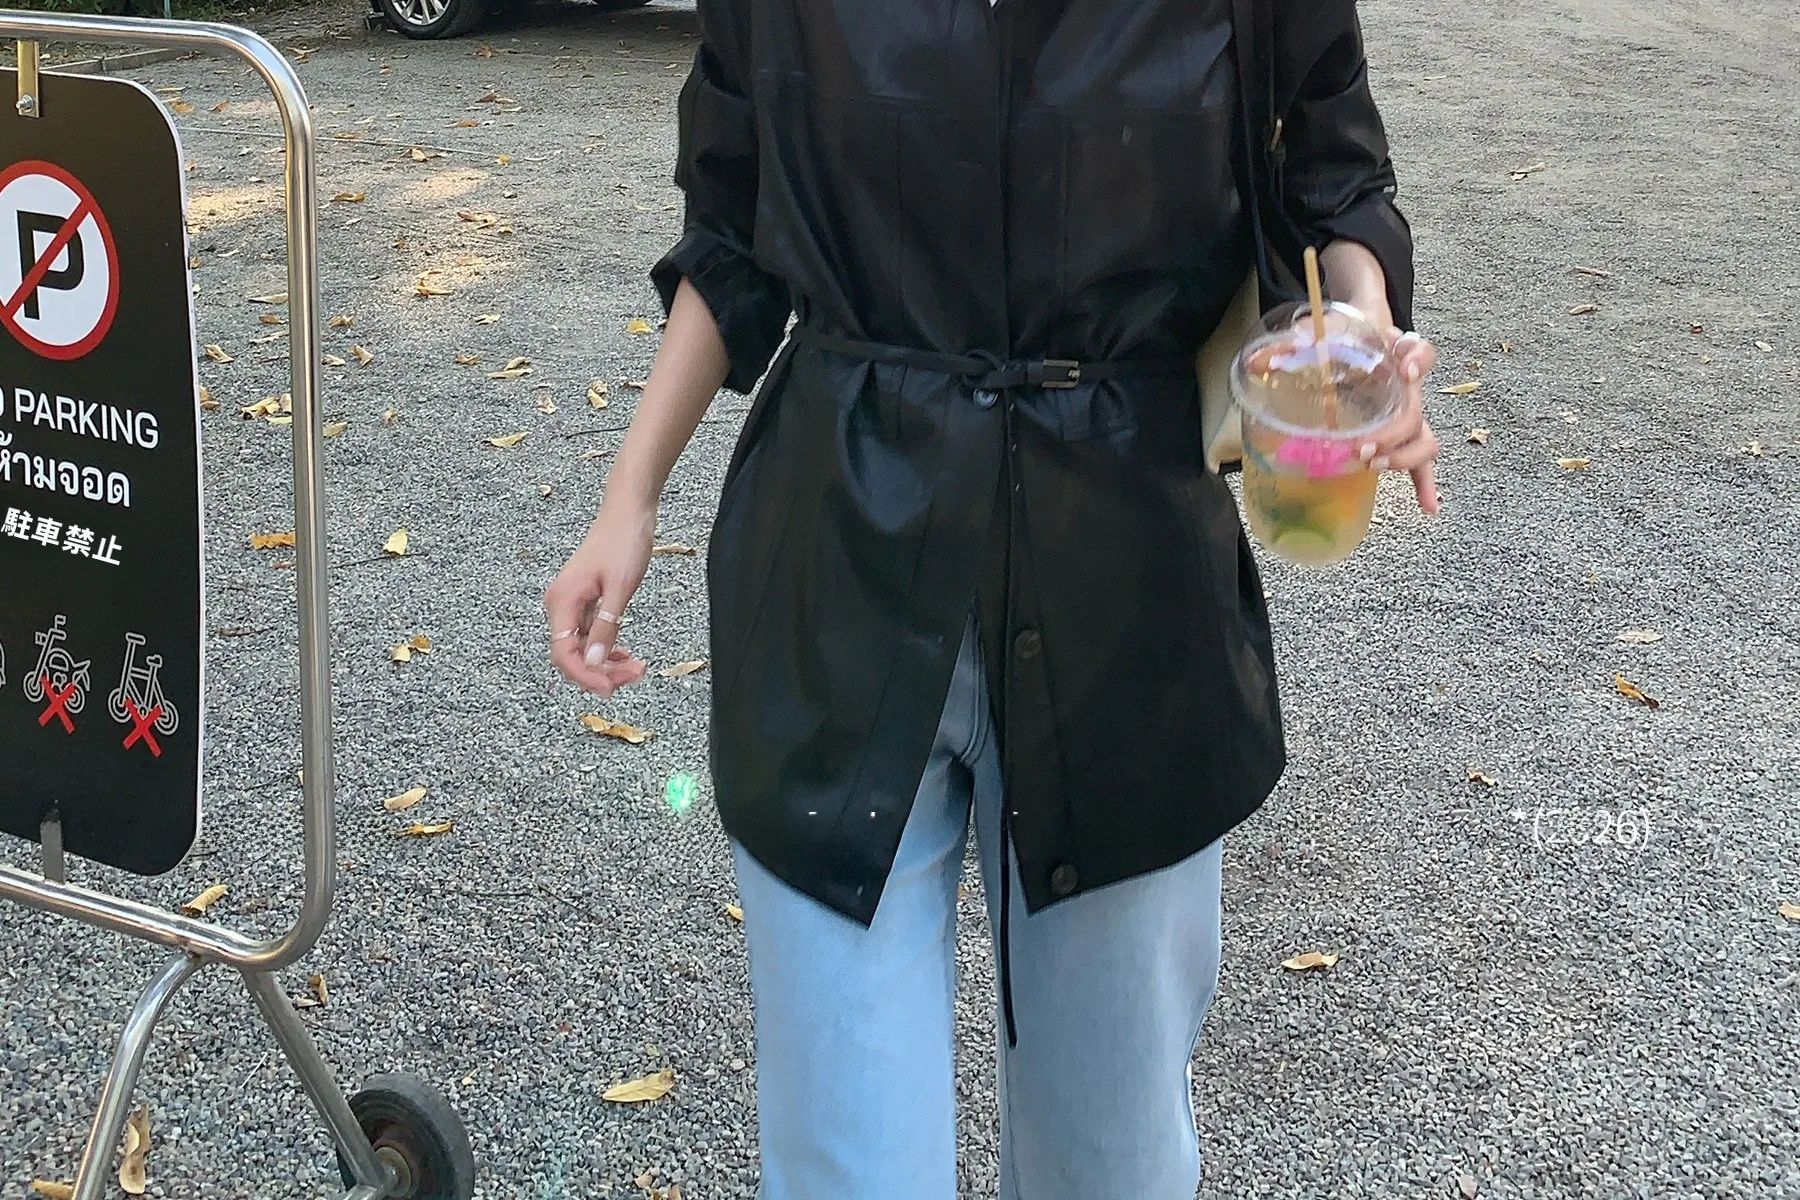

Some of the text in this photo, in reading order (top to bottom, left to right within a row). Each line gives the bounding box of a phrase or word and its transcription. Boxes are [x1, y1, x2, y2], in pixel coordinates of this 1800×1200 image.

[17, 210, 84, 320] P
[15, 388, 160, 449] PARKING
[1, 507, 123, 566] 駐車禁止
